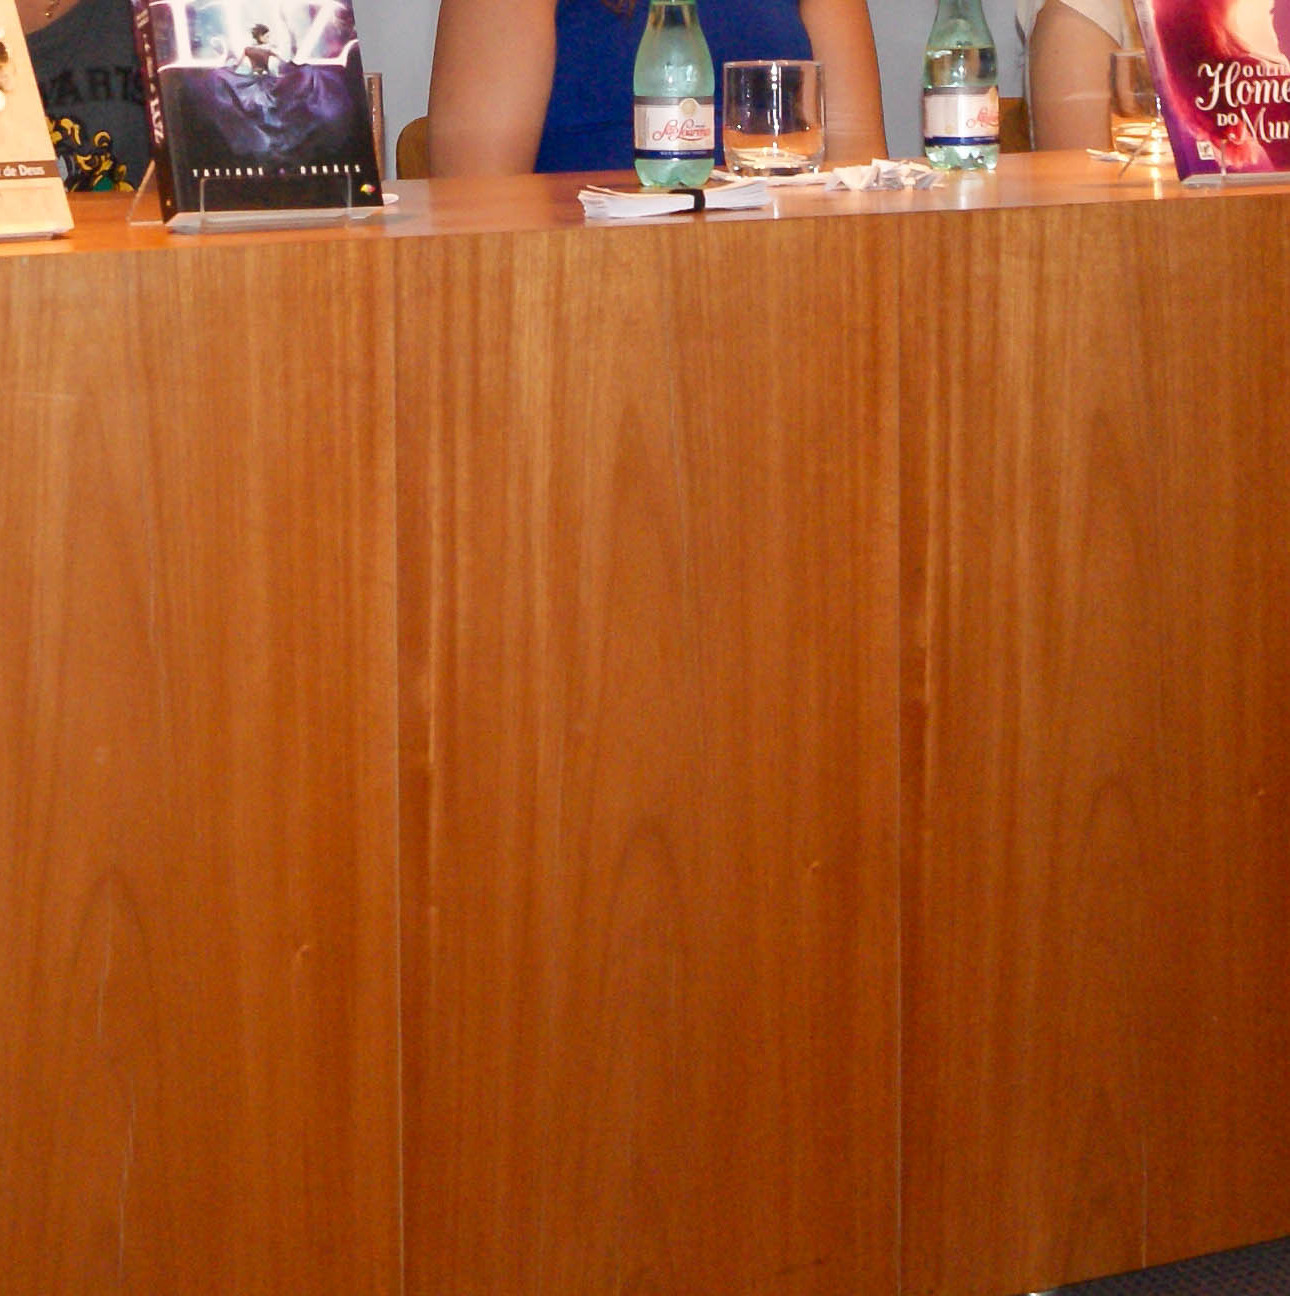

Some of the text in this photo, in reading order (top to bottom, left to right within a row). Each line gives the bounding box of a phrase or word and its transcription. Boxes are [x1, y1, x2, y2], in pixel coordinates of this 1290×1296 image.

[1217, 113, 1239, 126] DO
[3, 165, 18, 176] de
[19, 164, 46, 176] Deus
